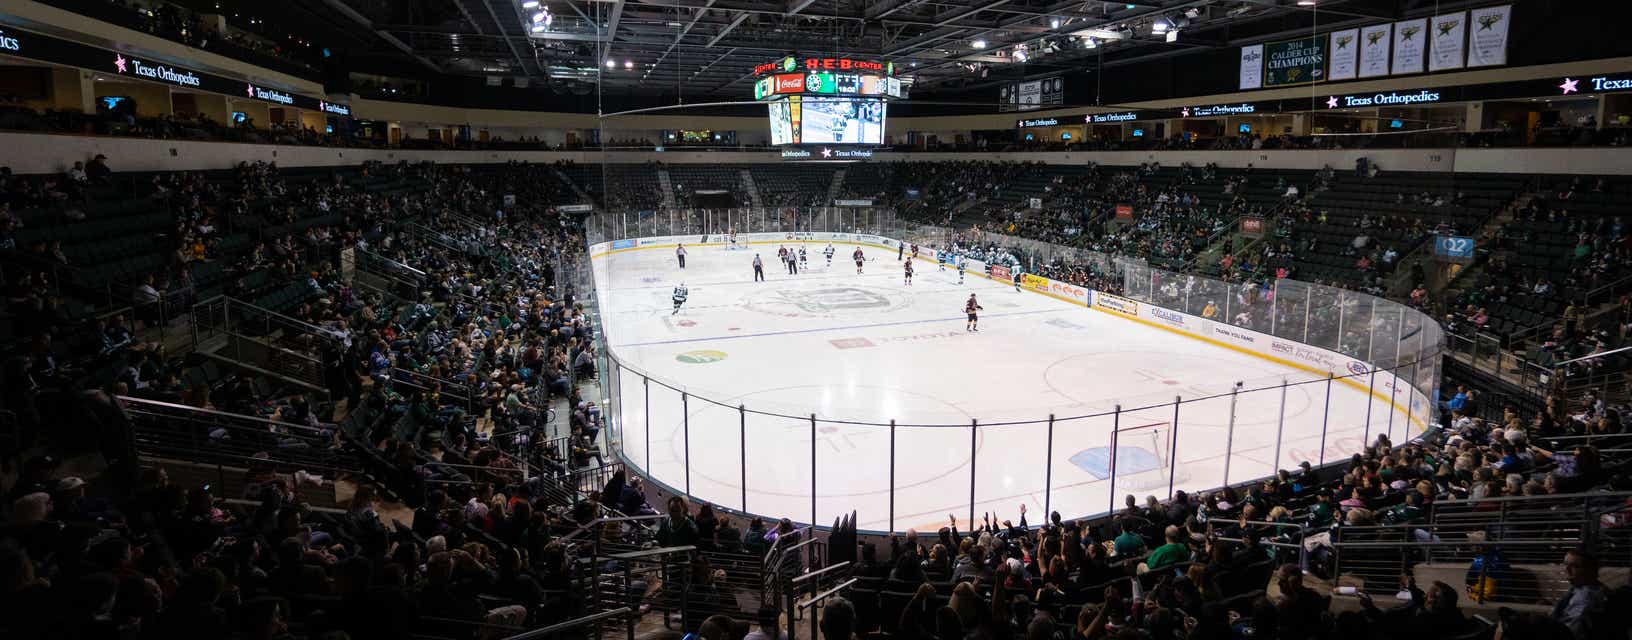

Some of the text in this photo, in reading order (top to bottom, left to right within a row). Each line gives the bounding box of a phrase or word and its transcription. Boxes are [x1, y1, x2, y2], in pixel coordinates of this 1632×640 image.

[1303, 46, 1320, 56] CUP
[854, 61, 882, 71] CENTER
[1268, 54, 1322, 69] CHAMPIONS
[132, 60, 200, 86] Texas Orthopedics
[1344, 91, 1439, 106] Texas Orthopedics
[1212, 103, 1254, 115] Orthopedics
[1094, 112, 1137, 123] Texas Orthopedics
